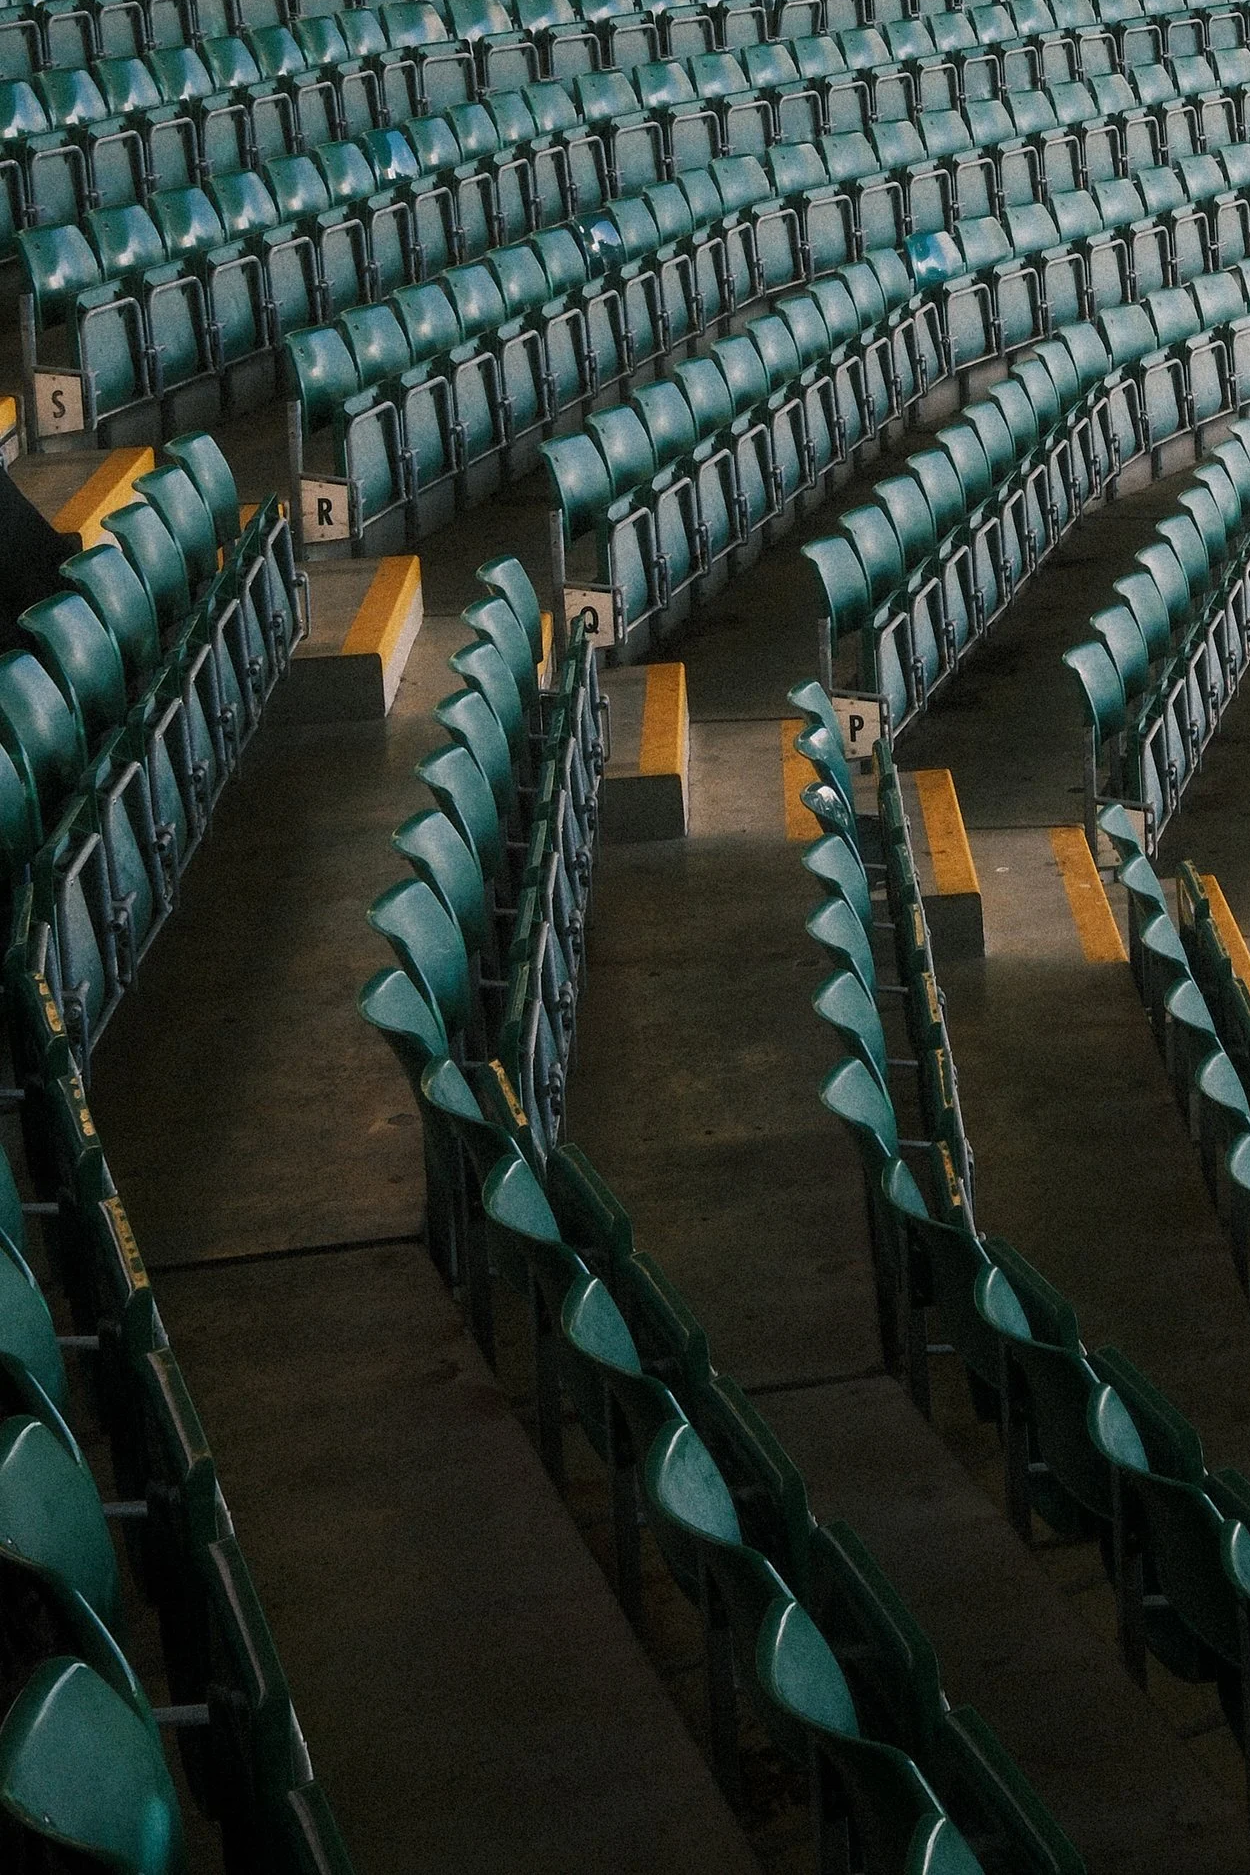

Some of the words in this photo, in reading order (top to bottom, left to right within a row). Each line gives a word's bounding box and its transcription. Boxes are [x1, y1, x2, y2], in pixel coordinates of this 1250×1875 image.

[51, 390, 66, 419] S
[317, 497, 334, 526] R
[580, 605, 600, 634] Q
[849, 715, 865, 742] P
